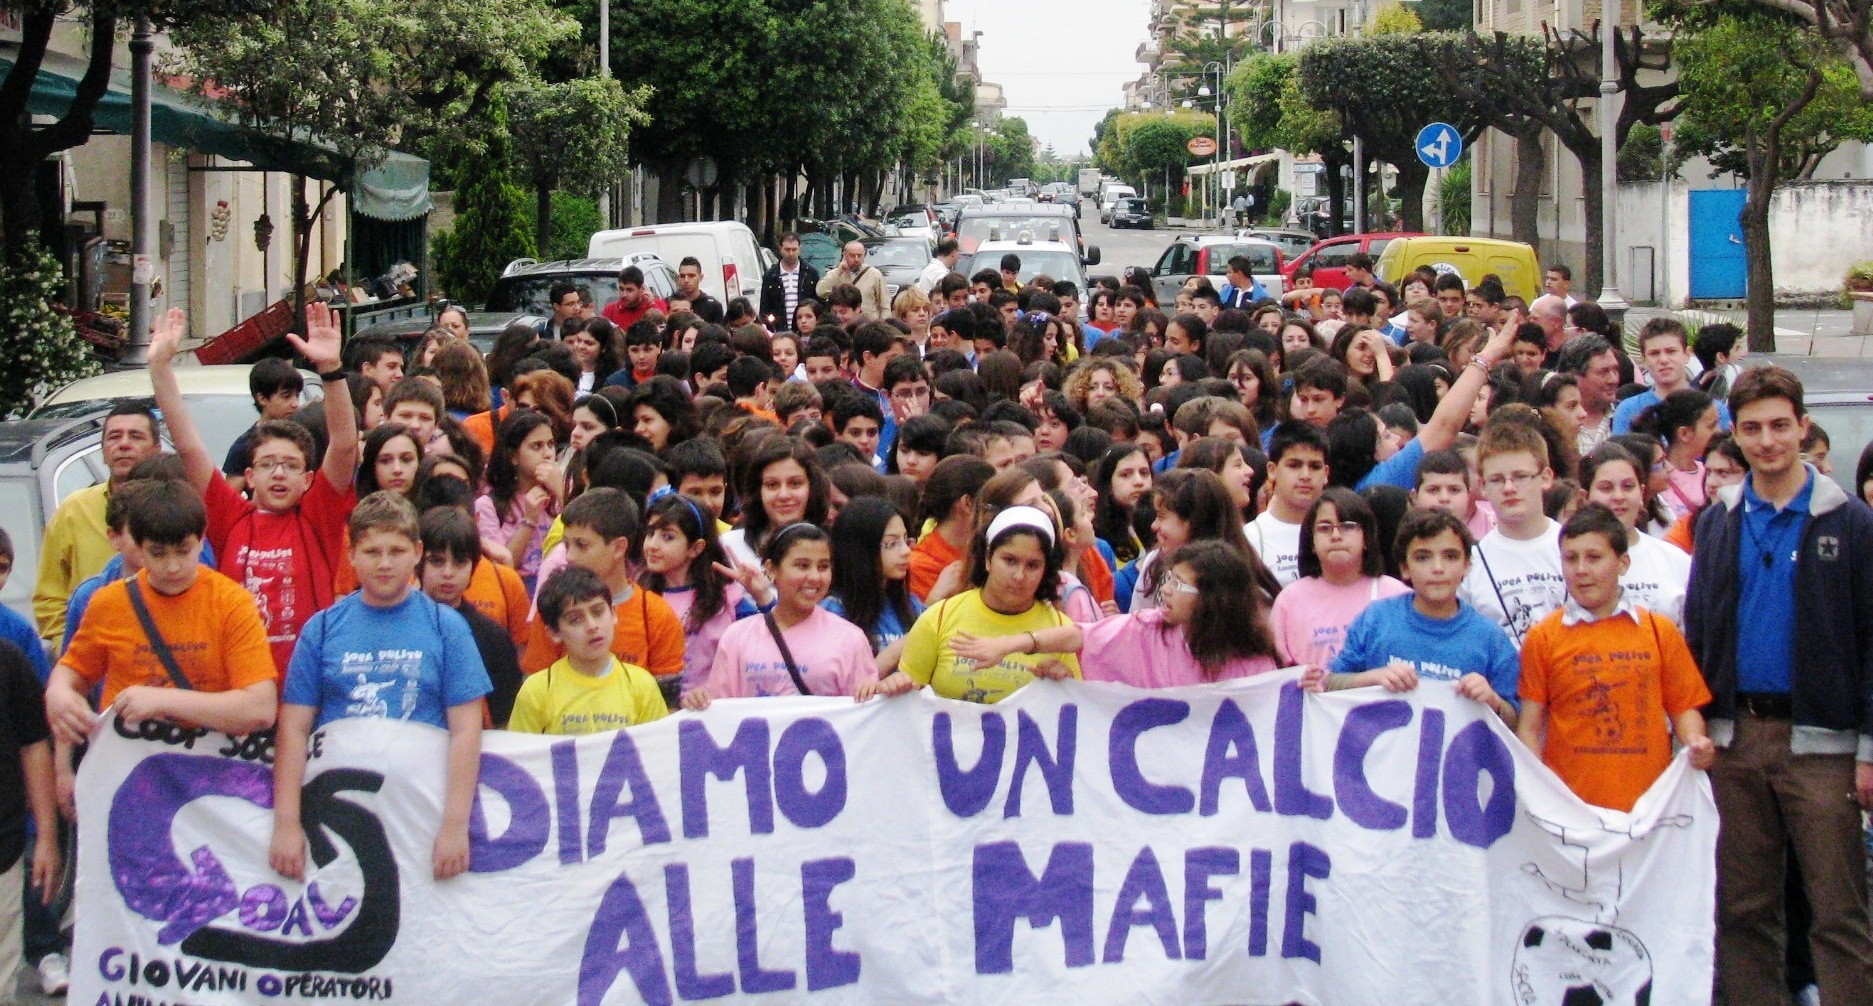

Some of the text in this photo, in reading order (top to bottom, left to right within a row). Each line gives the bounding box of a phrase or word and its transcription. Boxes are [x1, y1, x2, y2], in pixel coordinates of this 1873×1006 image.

[468, 679, 1517, 874] DIAMO UN CALCIO
[98, 946, 247, 993] GIOVANI
[256, 971, 394, 1000] OPERATORI
[577, 841, 1332, 1006] ALLE MAFIE
